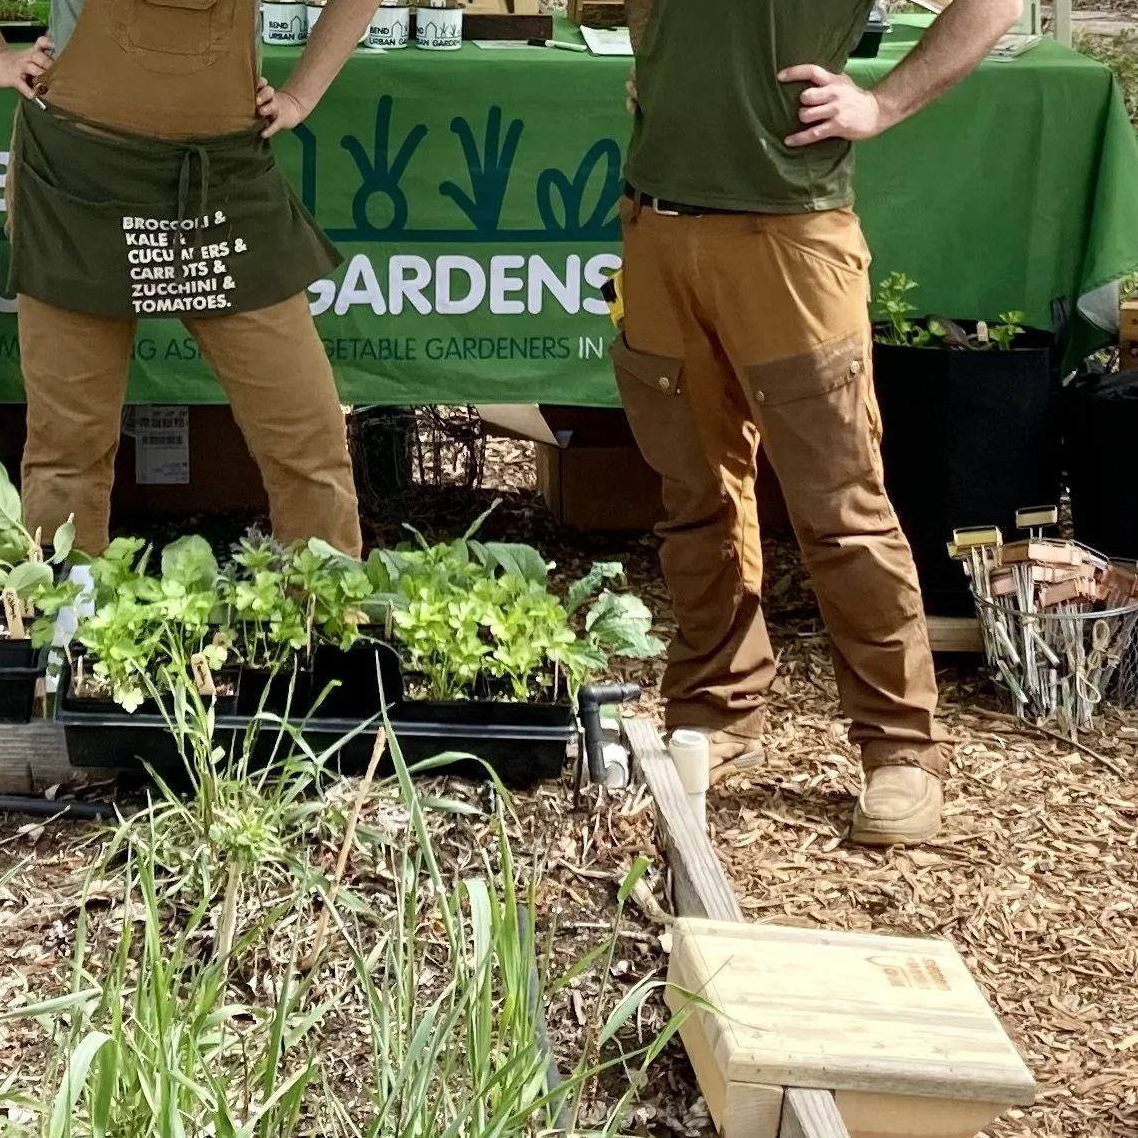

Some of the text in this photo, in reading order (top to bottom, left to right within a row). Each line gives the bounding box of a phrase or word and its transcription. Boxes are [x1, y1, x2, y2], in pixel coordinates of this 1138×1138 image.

[269, 21, 288, 29] BEND
[369, 38, 395, 46] URBAN
[214, 211, 226, 225] &
[125, 232, 168, 247] KALE
[234, 238, 247, 253] &
[213, 259, 227, 274] &
[131, 275, 236, 297] ZUCCHINI &
[132, 294, 232, 313] TOMATOES.
[324, 336, 603, 360] GETABLE GARDENERS IN
